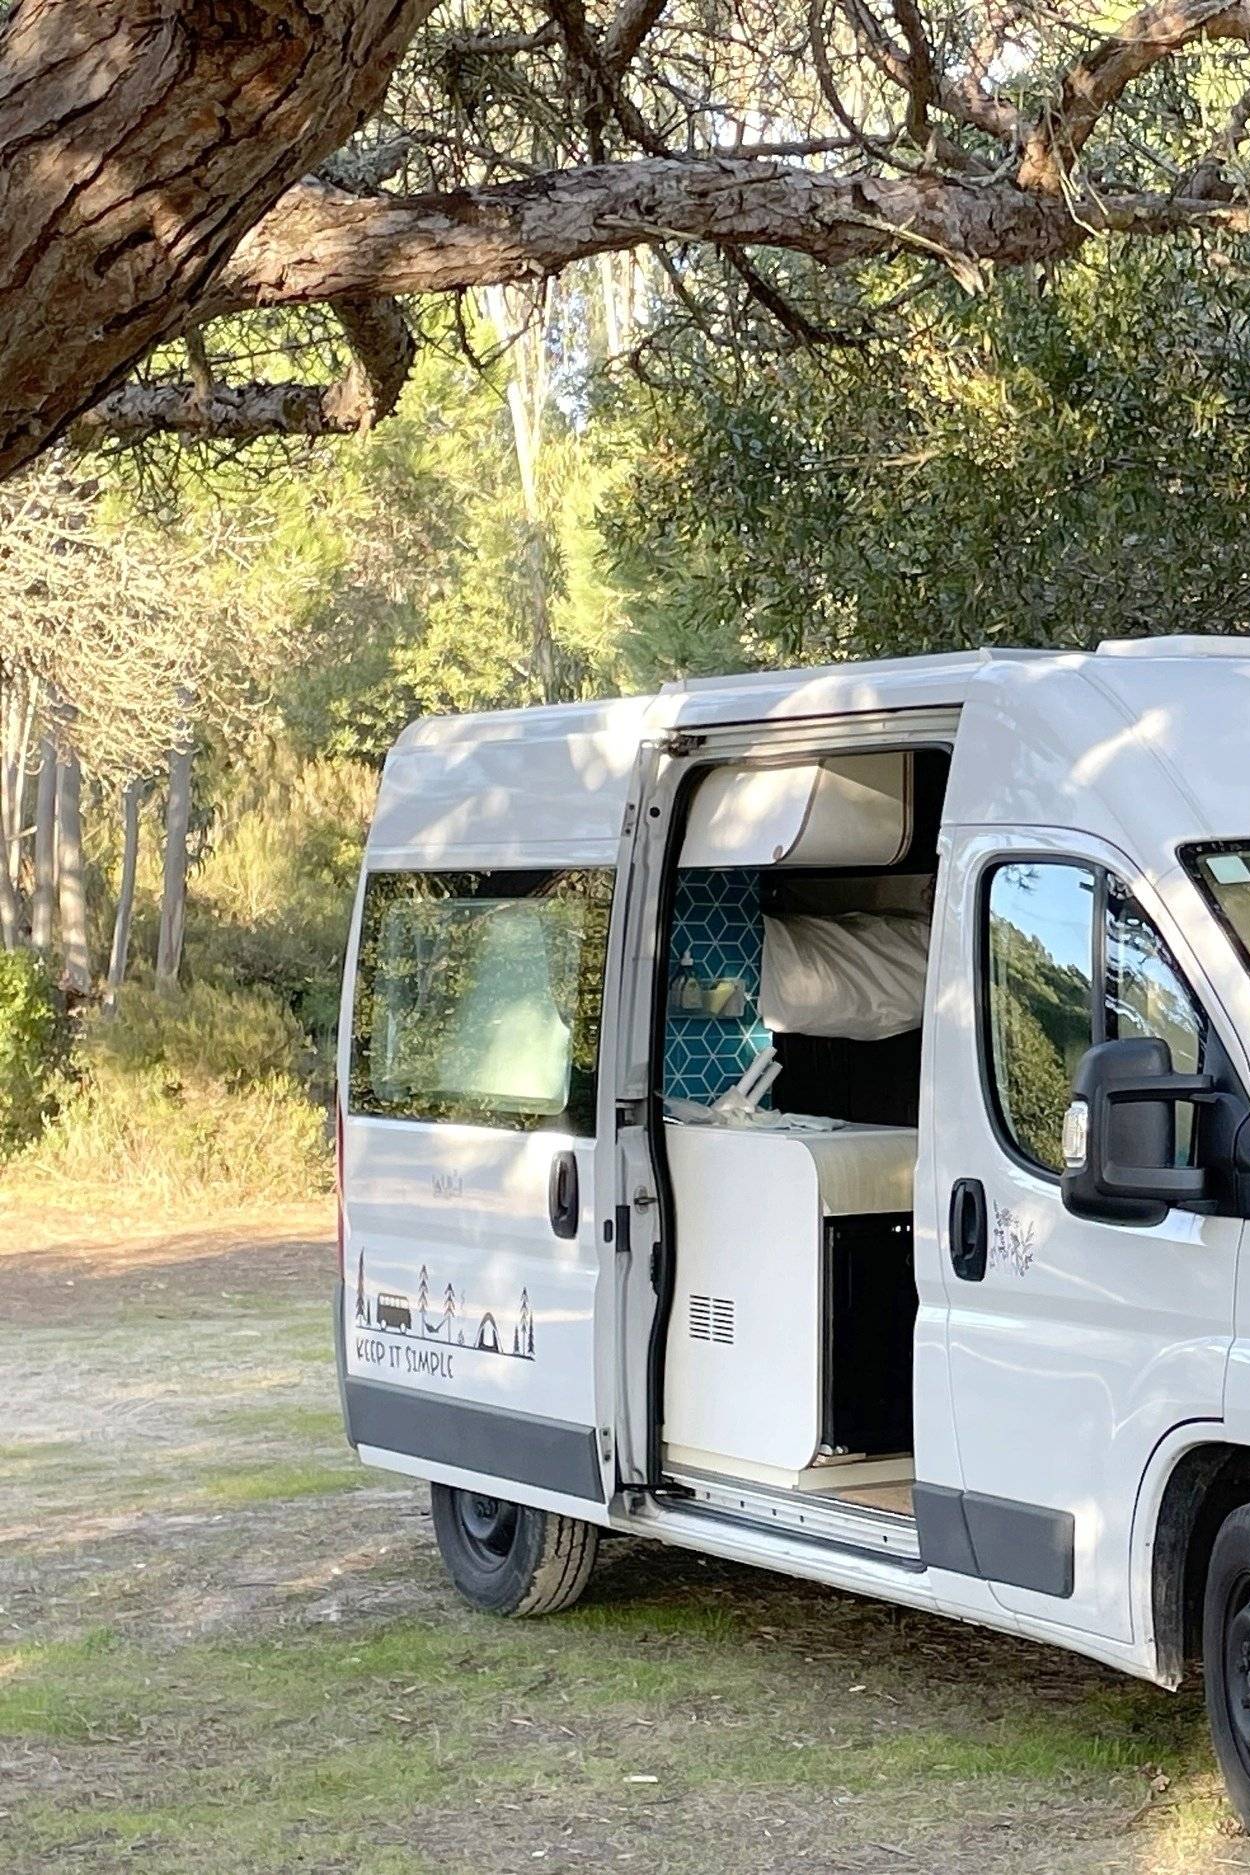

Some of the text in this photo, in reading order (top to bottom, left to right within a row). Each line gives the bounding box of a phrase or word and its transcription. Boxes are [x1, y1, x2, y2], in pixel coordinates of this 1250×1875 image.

[355, 1337, 454, 1379] KEEP IT SIMPLE
